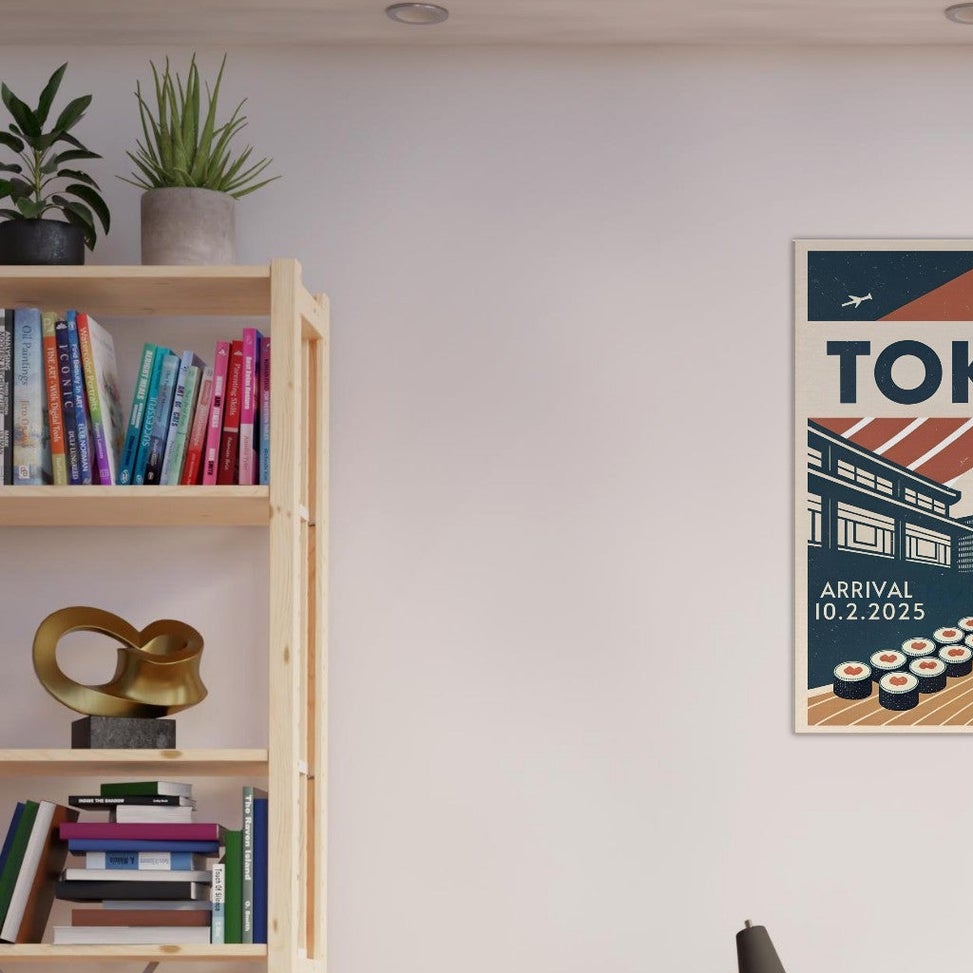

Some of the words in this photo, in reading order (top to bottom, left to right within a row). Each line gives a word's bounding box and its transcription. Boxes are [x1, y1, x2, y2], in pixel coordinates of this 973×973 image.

[21, 325, 33, 339] Oil
[47, 347, 58, 365] FINE
[80, 327, 92, 374] Watercolor
[18, 342, 32, 386] Paintings
[49, 365, 58, 380] ART
[73, 359, 82, 384] Beauty
[229, 364, 241, 397] Parenting
[85, 375, 98, 412] Portraits
[50, 402, 62, 425] Digital
[229, 398, 239, 416] Skills
[142, 396, 158, 447] SUCCESSFUL
[52, 426, 63, 443] Tools
[79, 440, 89, 472] NORMAN
[819, 580, 913, 599] ARRIVAL
[814, 602, 925, 621] 10.2.2025
[215, 868, 223, 884] Touch
[244, 850, 252, 881] Island
